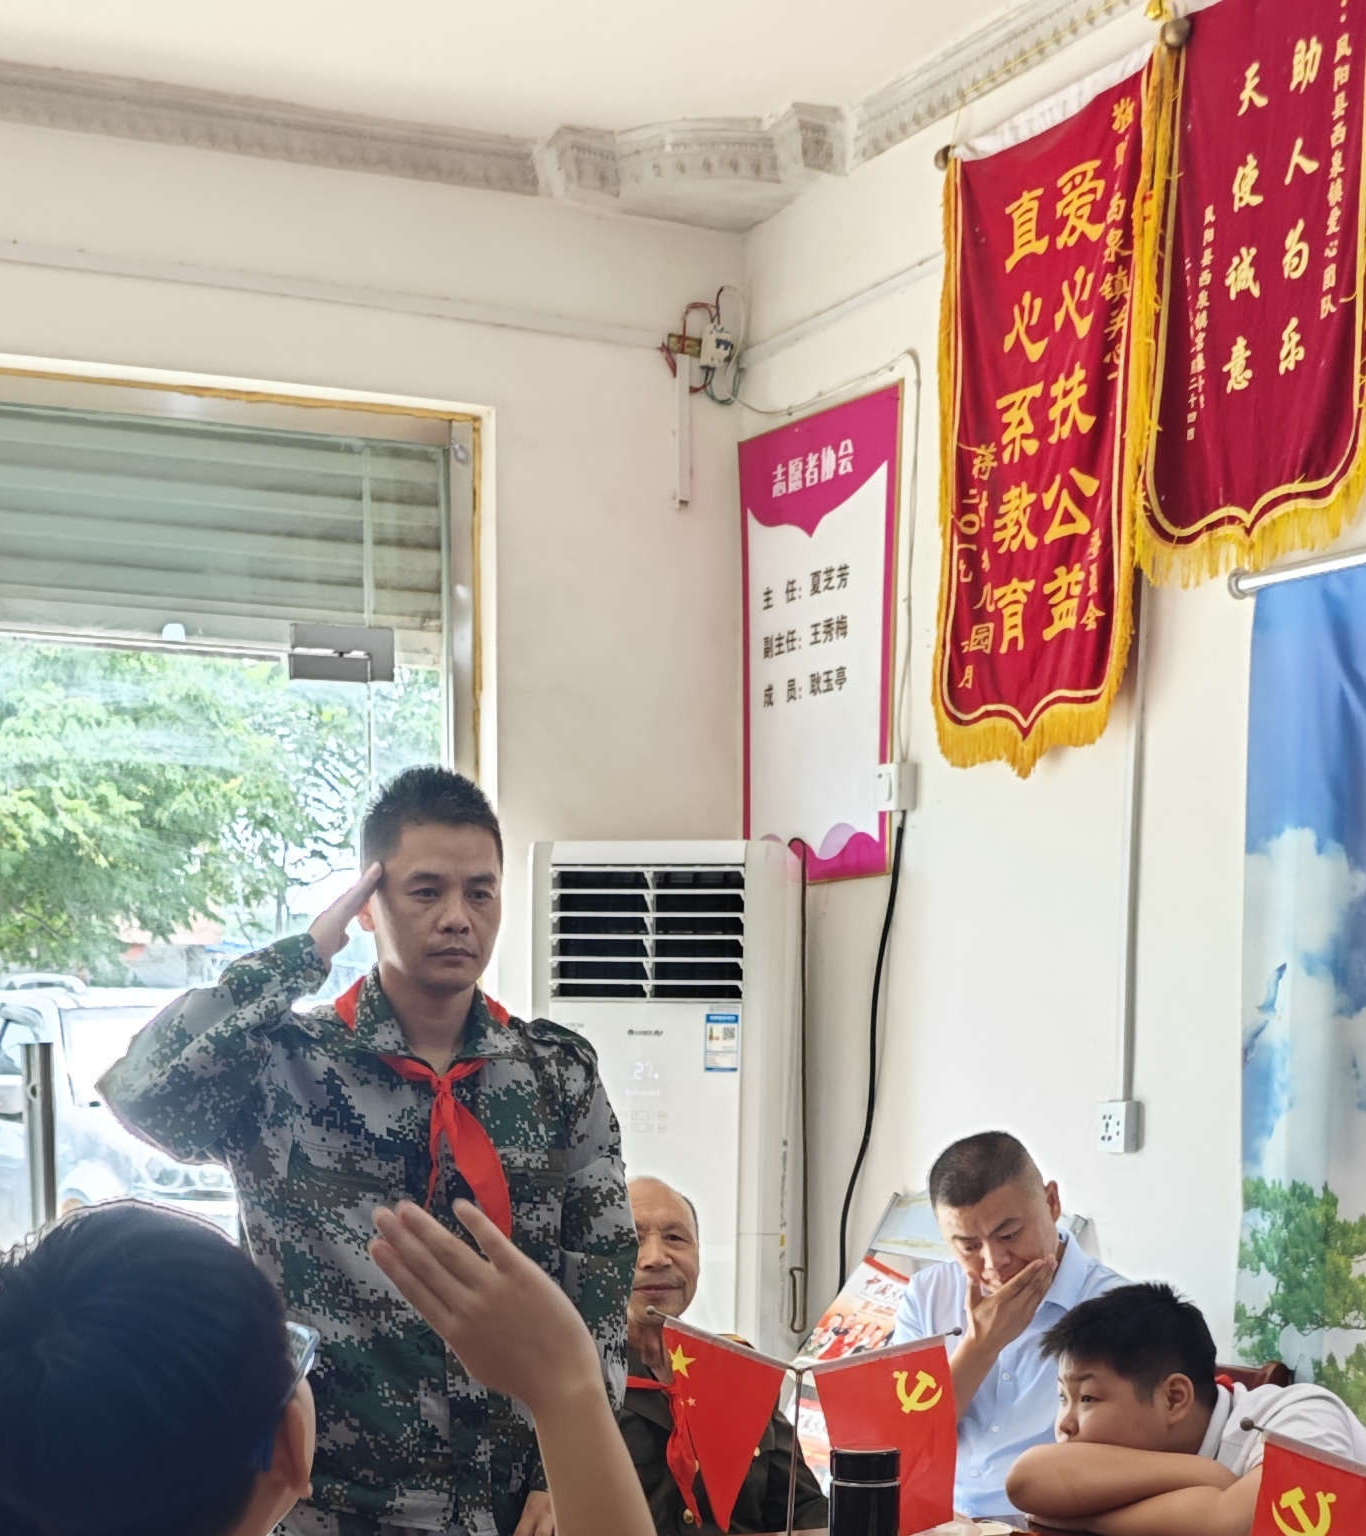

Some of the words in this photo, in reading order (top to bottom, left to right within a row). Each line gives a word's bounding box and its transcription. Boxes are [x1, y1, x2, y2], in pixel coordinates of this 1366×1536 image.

[1221, 60, 1269, 395] 天使诚意
[1277, 37, 1321, 376] 助人为乐
[771, 437, 855, 499] 志愿者协会
[993, 187, 1050, 654] 直心系教育
[1041, 159, 1107, 643] 爱心扶公益
